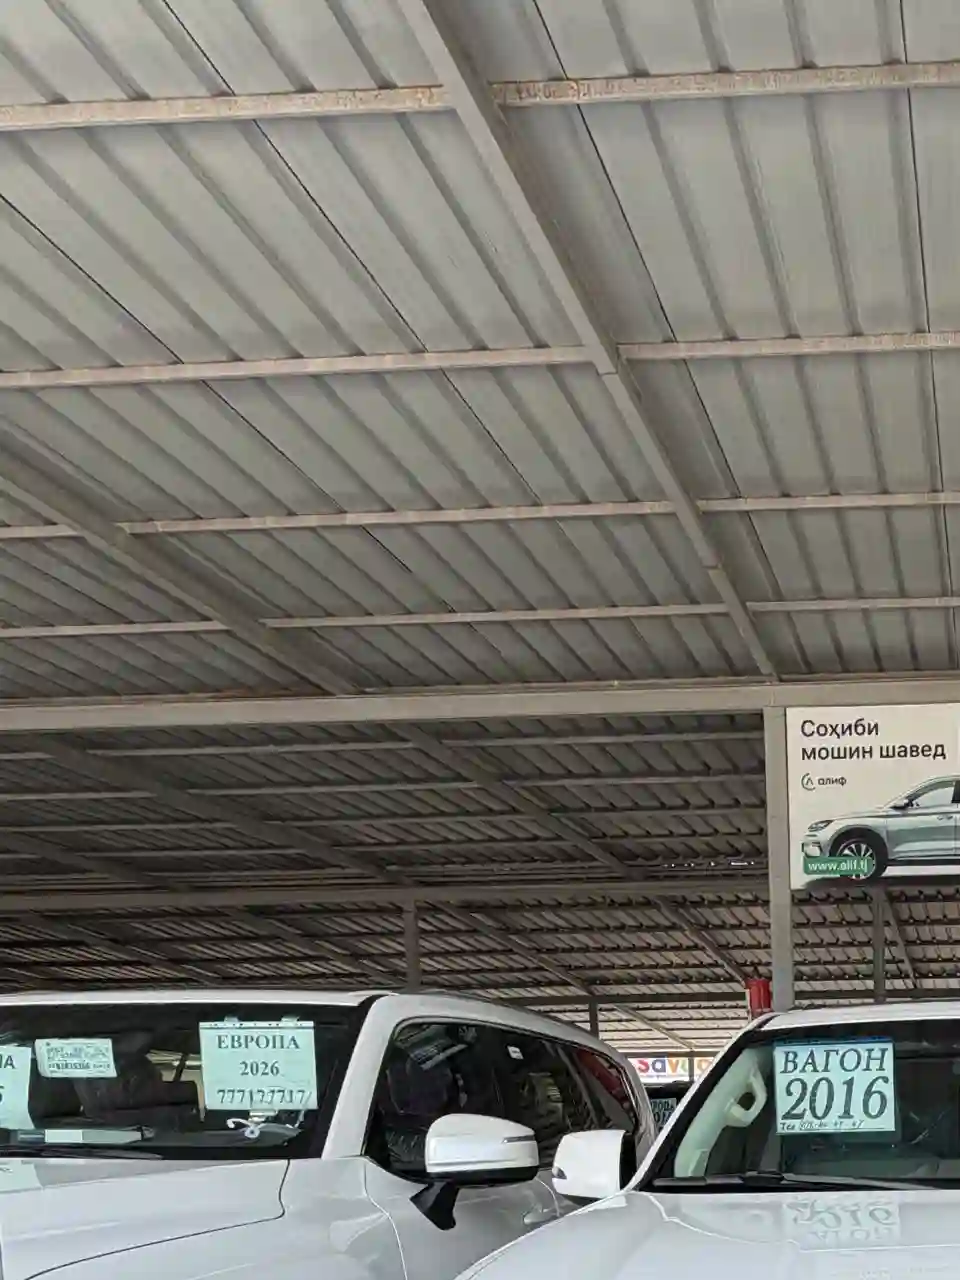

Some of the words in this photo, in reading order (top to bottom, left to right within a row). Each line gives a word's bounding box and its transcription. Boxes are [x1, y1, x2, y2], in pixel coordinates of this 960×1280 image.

[800, 718, 879, 740] Соҳиби
[801, 746, 873, 761] мошин
[880, 743, 947, 761] шавед
[817, 775, 847, 787] алиф
[807, 859, 868, 873] www.alif.tj
[217, 1034, 300, 1050] ЕВРОПА
[239, 1060, 280, 1077] 2026
[780, 1047, 889, 1074] ВАГОН
[781, 1074, 890, 1121] 2016
